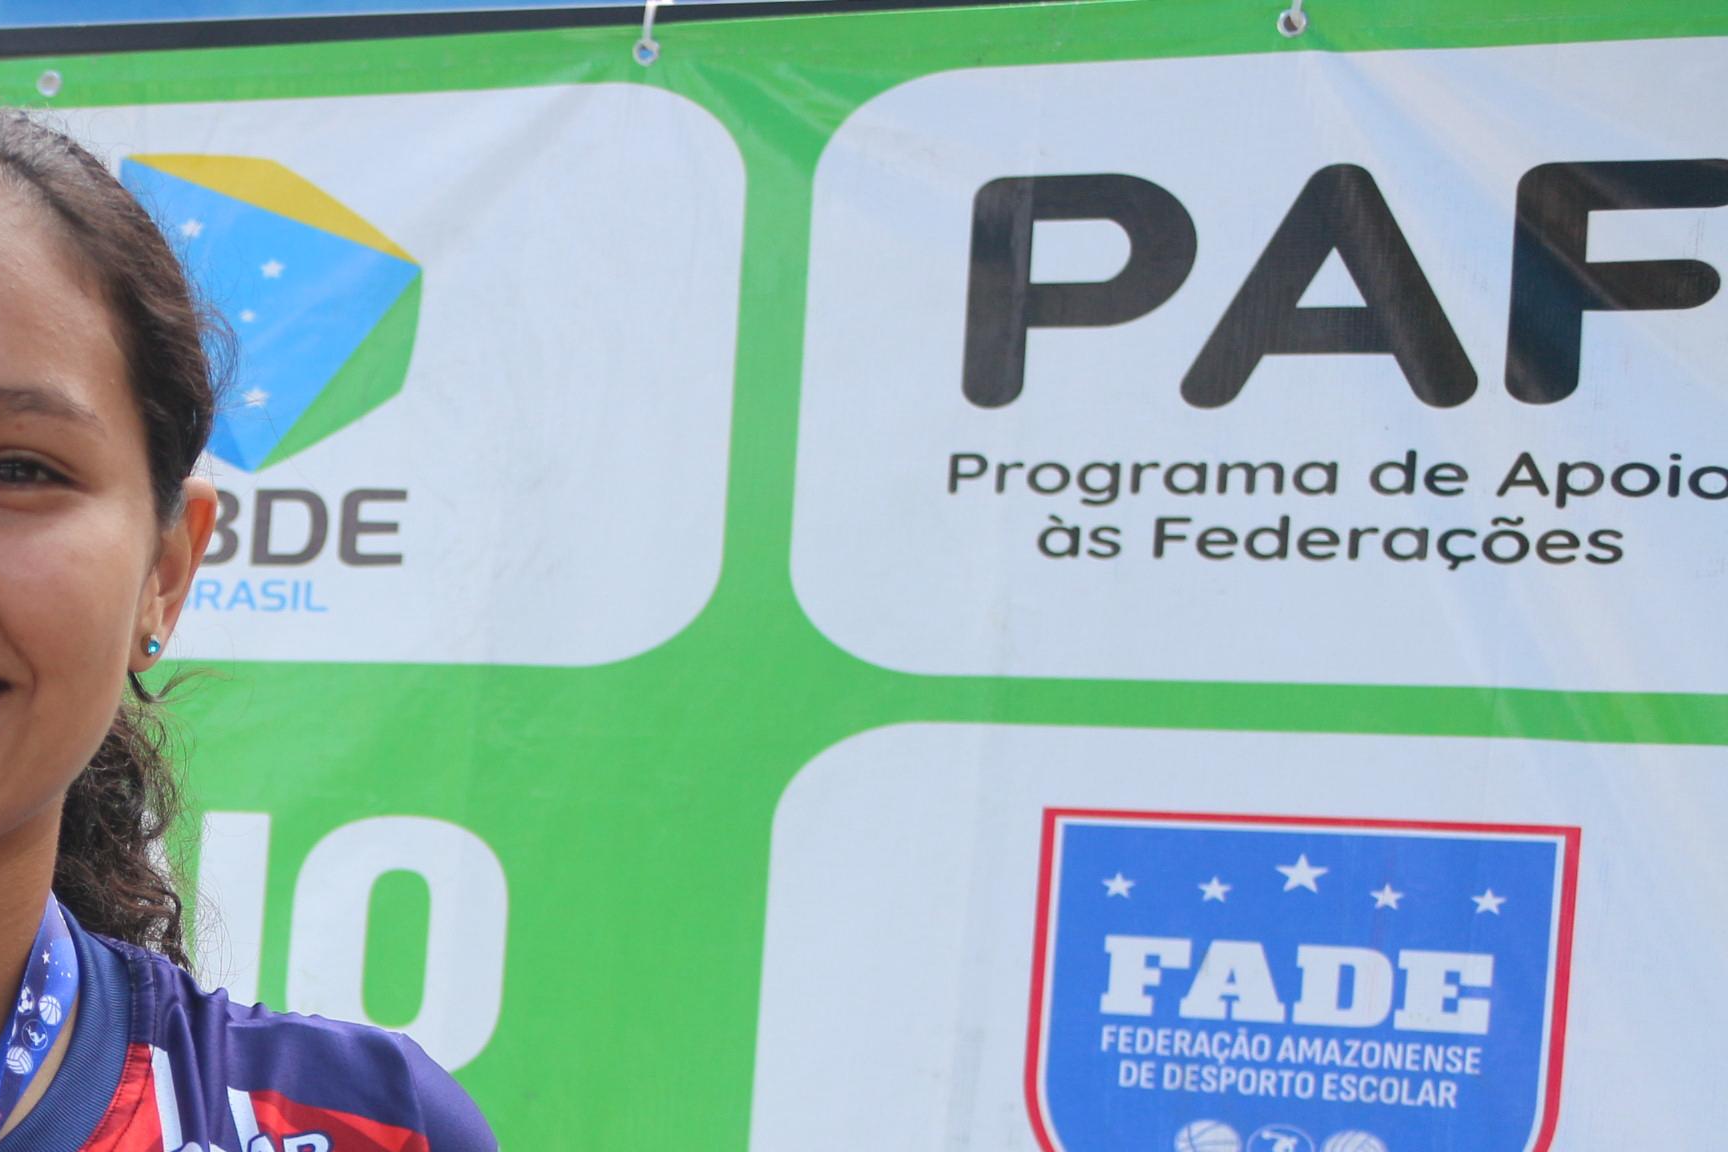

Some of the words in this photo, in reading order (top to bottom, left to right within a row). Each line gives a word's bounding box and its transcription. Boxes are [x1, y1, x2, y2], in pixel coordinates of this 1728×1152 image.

[962, 158, 1728, 408] PAF
[946, 451, 1339, 507] Programa
[1369, 450, 1469, 497] de
[1495, 450, 1728, 509] Apoio
[1037, 516, 1122, 559] às
[1151, 515, 1625, 570] Federações
[184, 579, 328, 612] RASIL
[1100, 935, 1494, 1035] FADE
[1100, 1024, 1272, 1067] FEDERAÇÃO
[1277, 1035, 1482, 1075] AMAZONENSE
[1117, 1060, 1155, 1089] DE
[1162, 1063, 1317, 1100] DESPORTO
[1321, 1071, 1458, 1109] ESCOLAR
